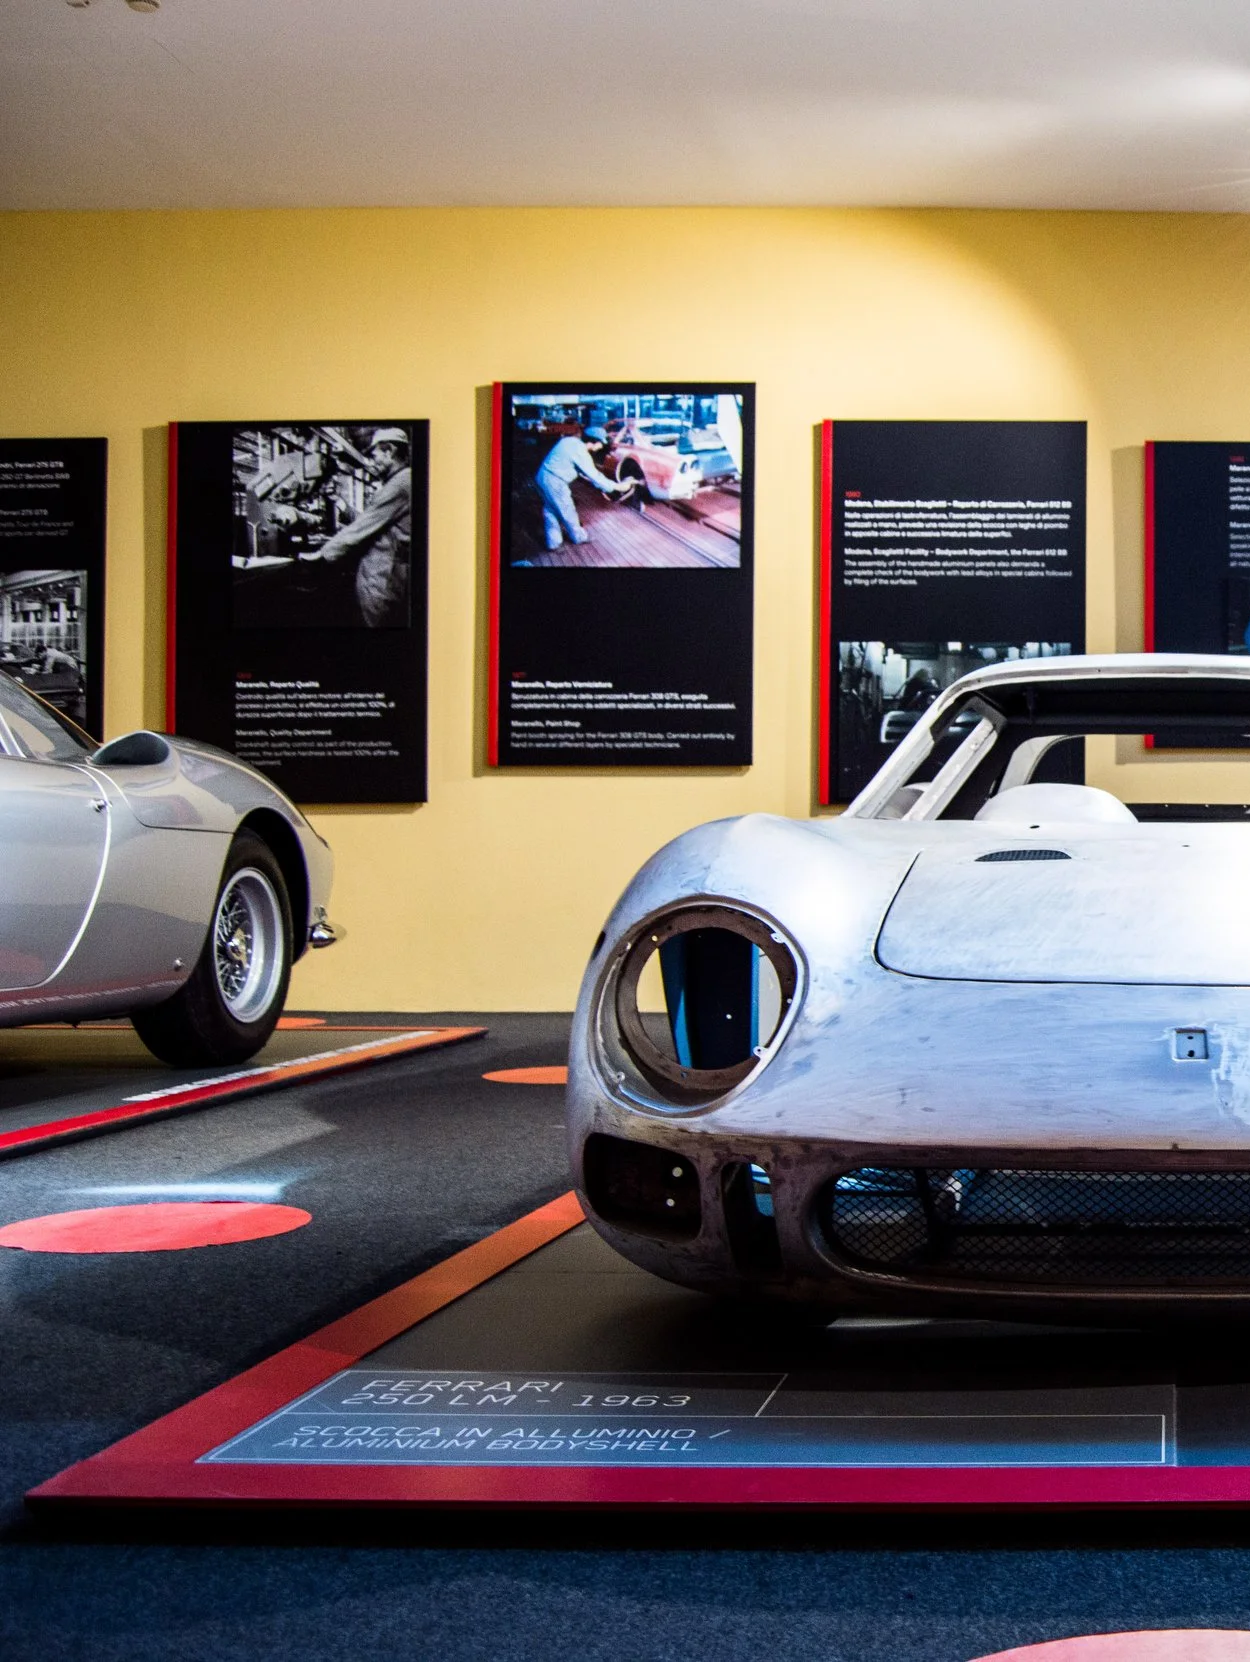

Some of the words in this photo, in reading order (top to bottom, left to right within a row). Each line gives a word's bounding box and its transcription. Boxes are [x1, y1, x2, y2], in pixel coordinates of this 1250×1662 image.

[362, 1380, 563, 1393] FERRARI
[341, 1393, 434, 1405] 250
[449, 1394, 517, 1406] LM
[572, 1395, 691, 1407] 1963
[294, 1426, 440, 1437] SCOCCA
[456, 1427, 493, 1438] IN
[501, 1428, 696, 1438] ALLUMINIO
[272, 1437, 476, 1450] ALUMINIUM
[486, 1439, 698, 1450] BODYSHELL
